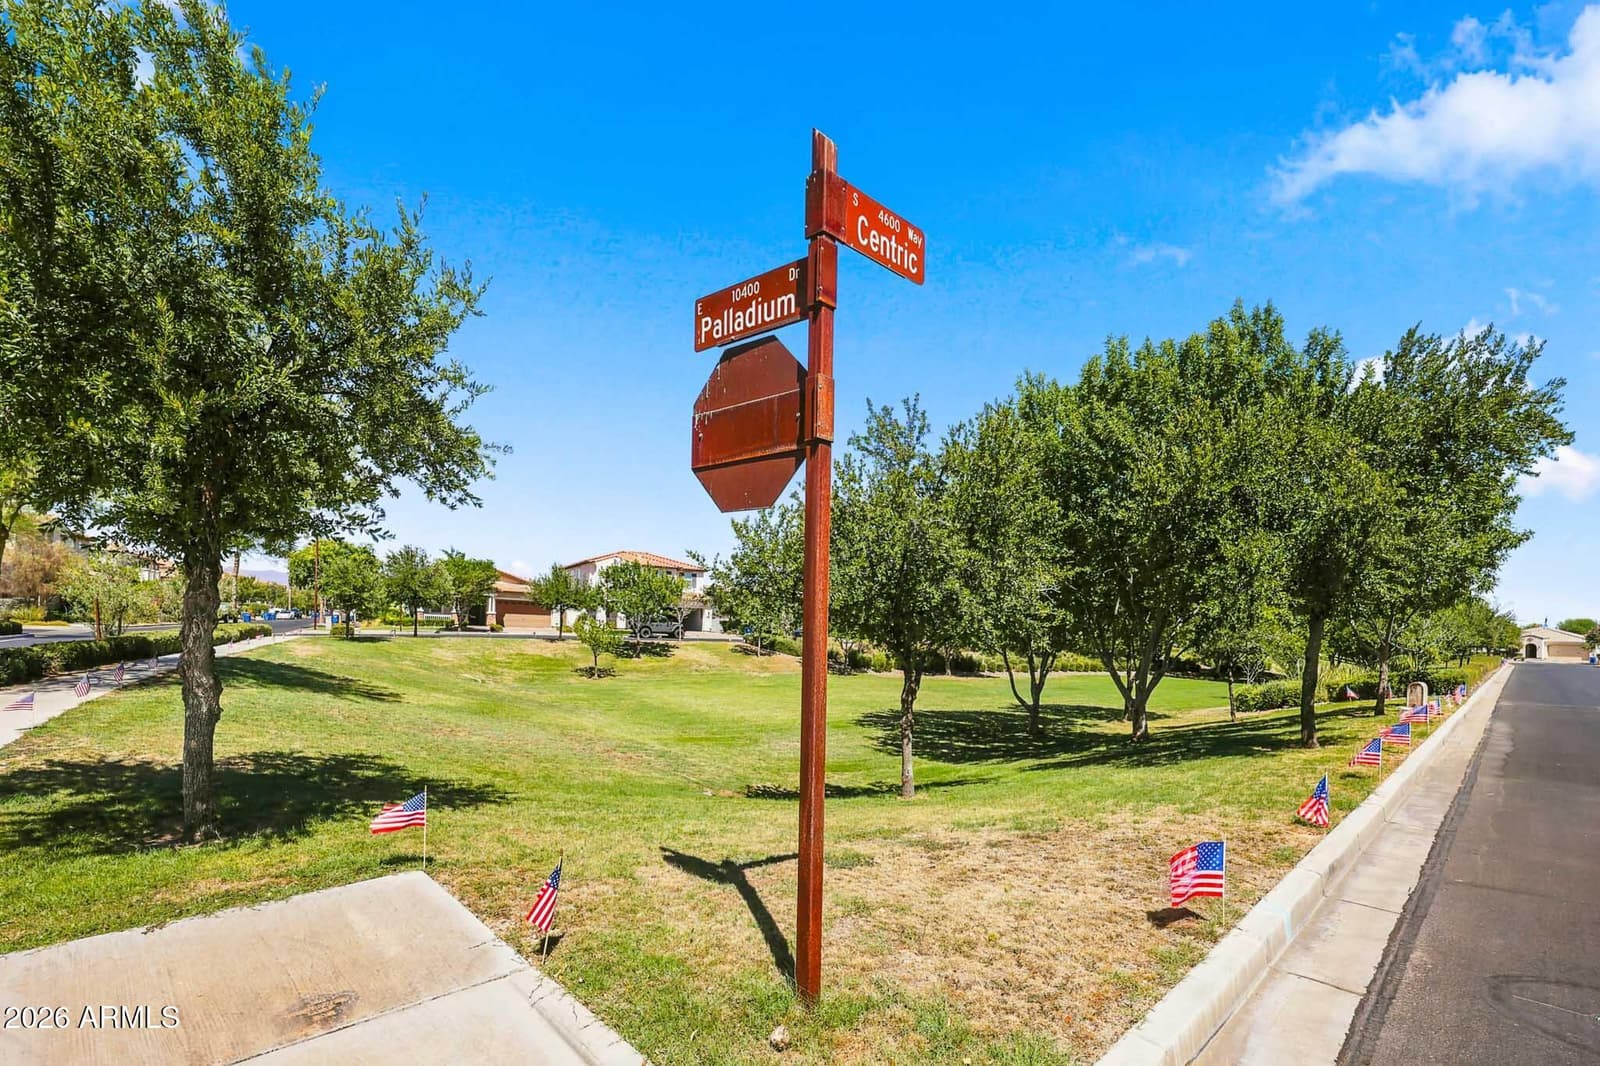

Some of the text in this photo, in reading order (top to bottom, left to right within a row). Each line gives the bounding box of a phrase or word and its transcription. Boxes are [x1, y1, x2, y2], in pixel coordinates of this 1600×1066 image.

[852, 192, 923, 248] S 4600 Way
[857, 215, 917, 274] Centric
[697, 267, 800, 315] E 10400 Dr
[701, 292, 796, 343] Palladium
